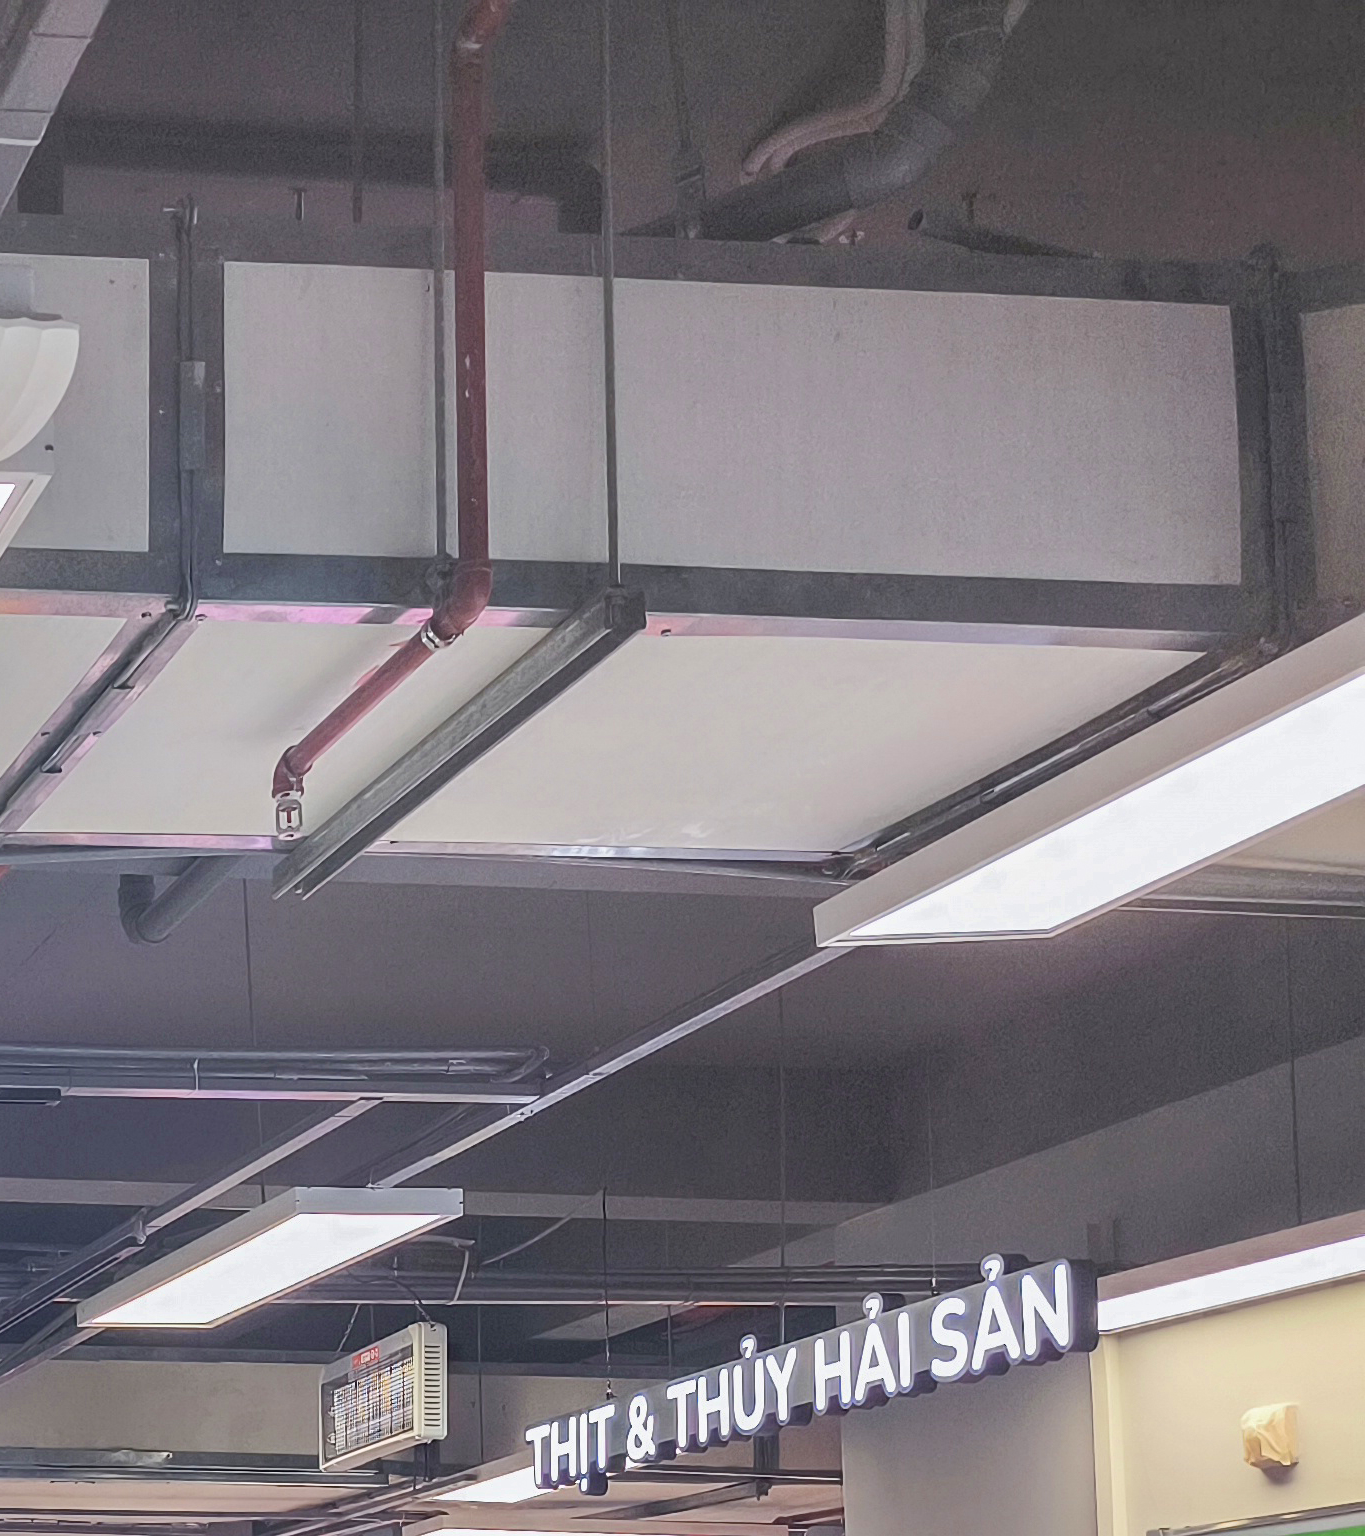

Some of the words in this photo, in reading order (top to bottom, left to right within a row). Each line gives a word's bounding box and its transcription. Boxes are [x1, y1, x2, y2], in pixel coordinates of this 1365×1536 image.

[525, 1404, 615, 1493] THỊT
[626, 1394, 656, 1462] &
[667, 1337, 798, 1454] THỦY
[813, 1296, 912, 1411] HẢI
[929, 1259, 1071, 1381] SẢN
